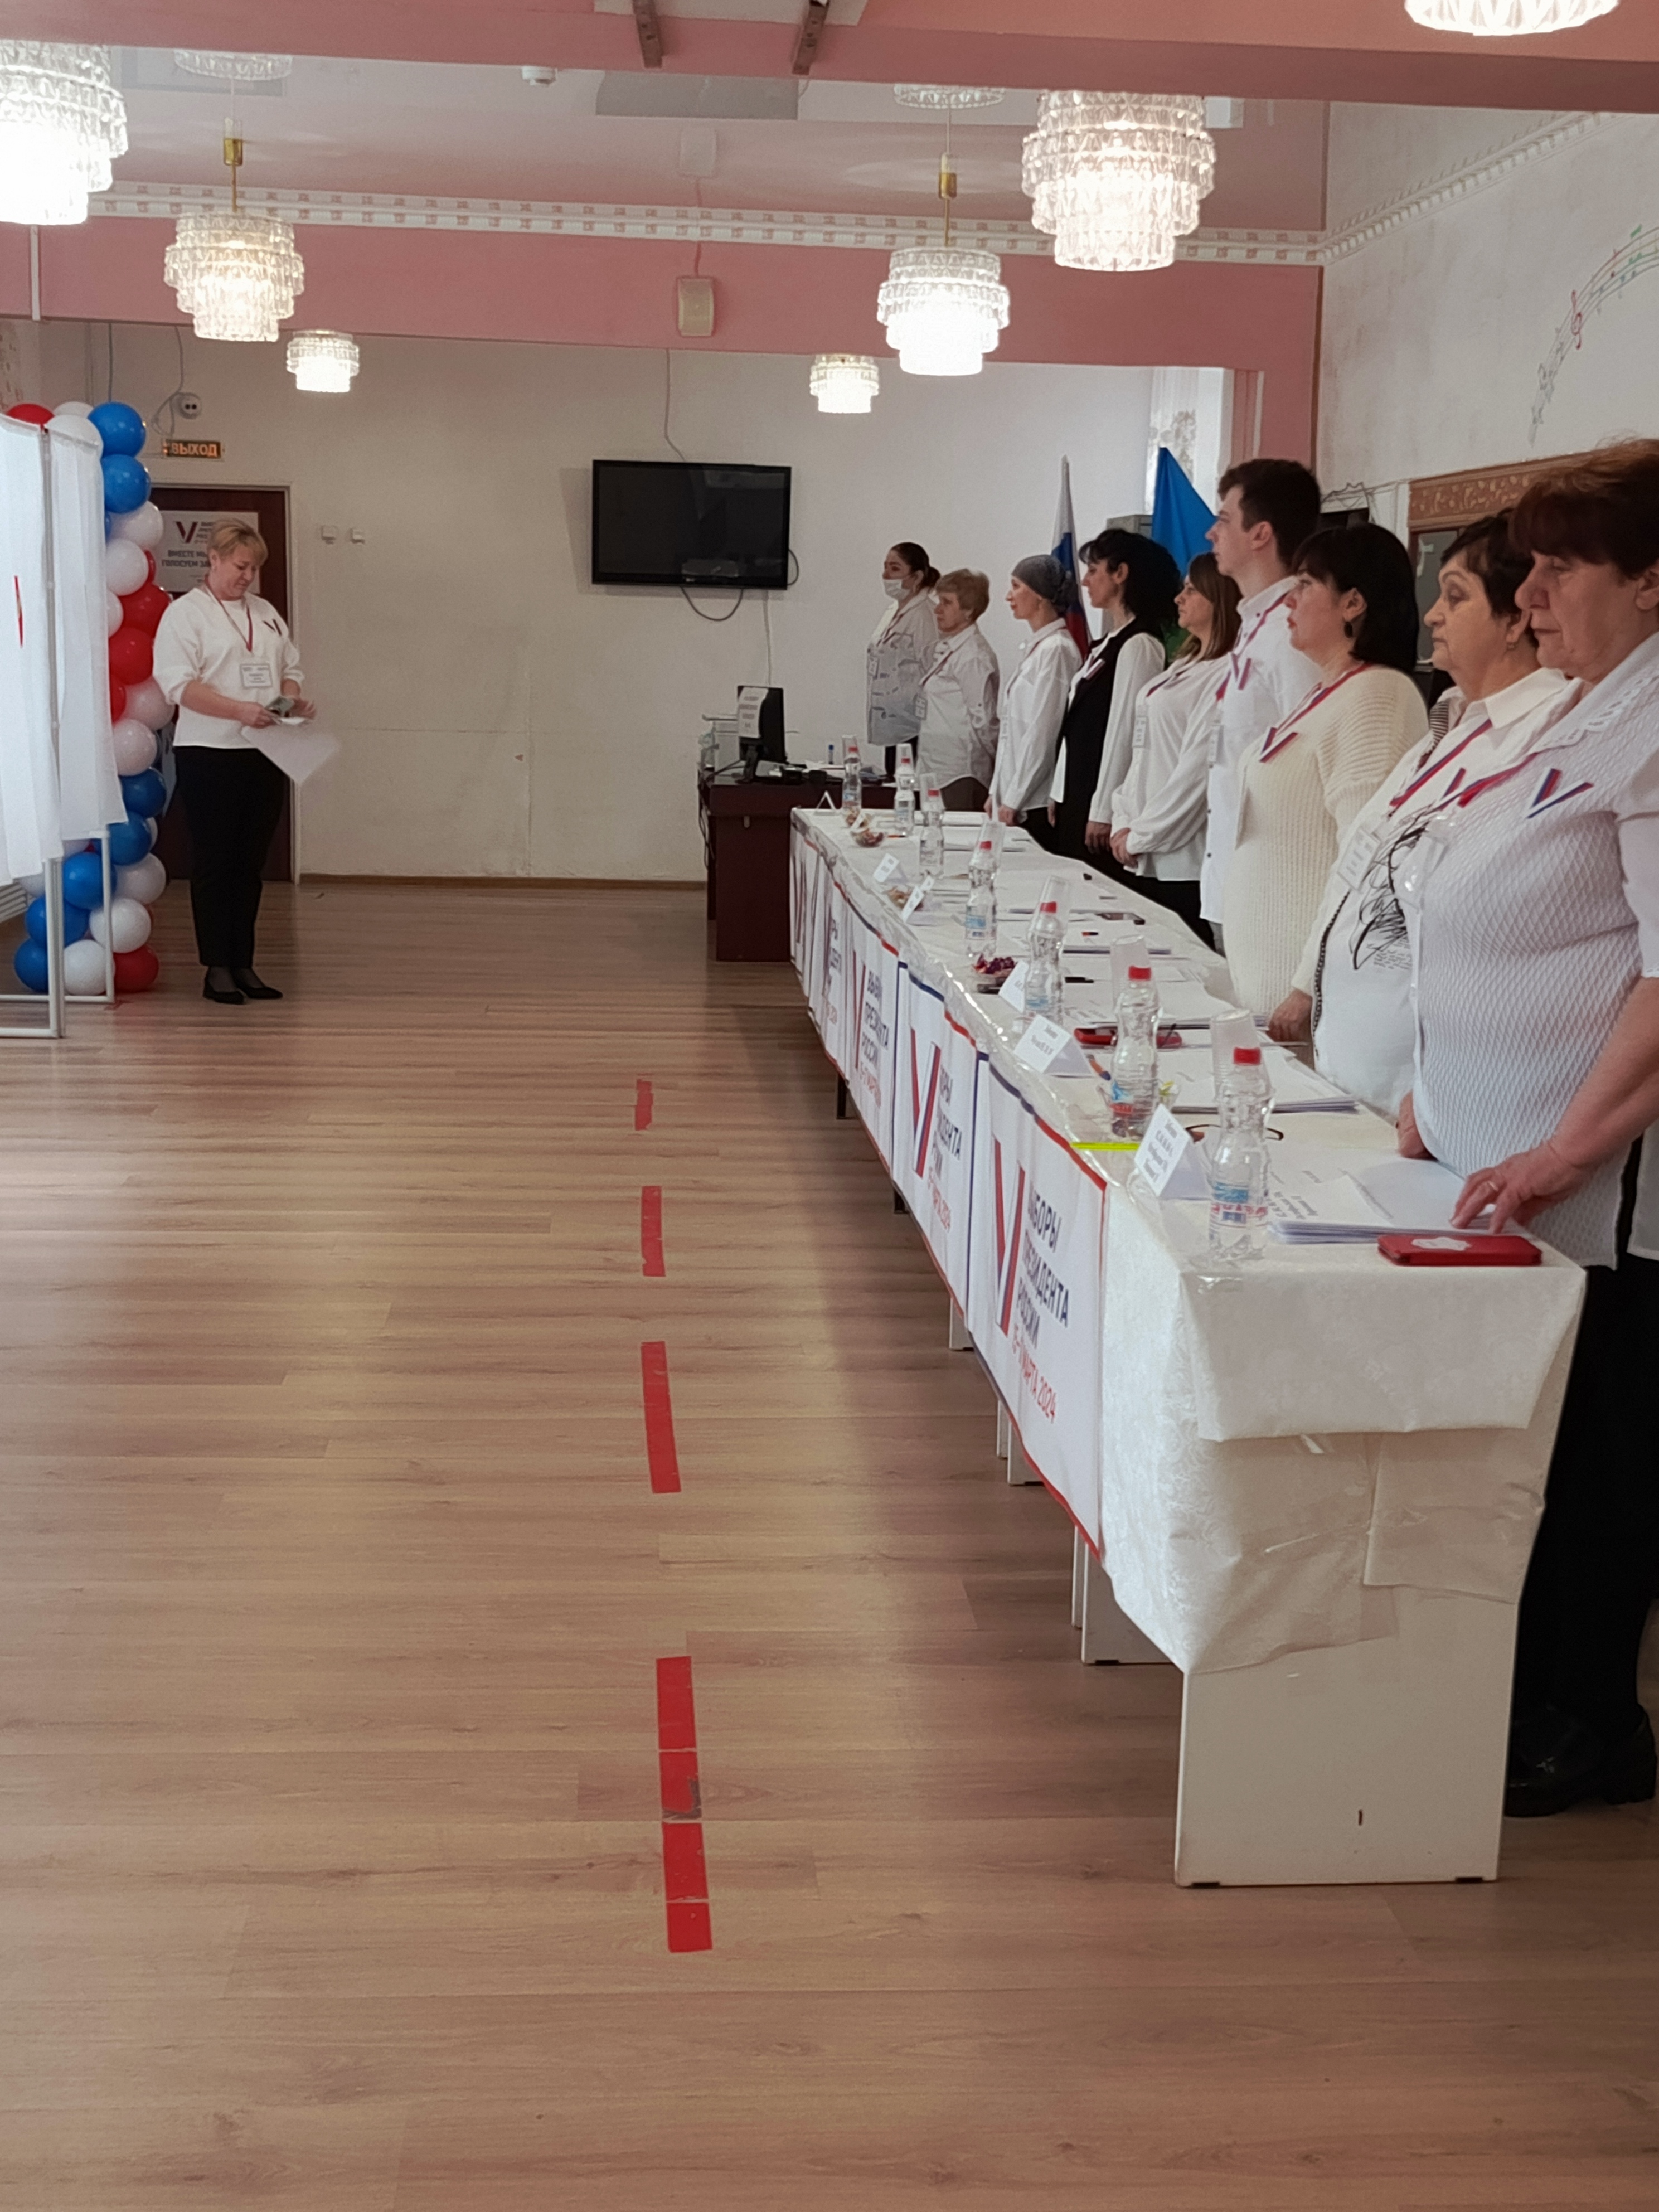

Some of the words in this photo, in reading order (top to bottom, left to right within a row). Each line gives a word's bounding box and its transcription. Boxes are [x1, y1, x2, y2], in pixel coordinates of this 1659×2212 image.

[171, 443, 217, 457] ВЫХОД
[1027, 1178, 1062, 1253] БОРЫ
[1022, 1227, 1069, 1328] ЕЗИДЕНТА
